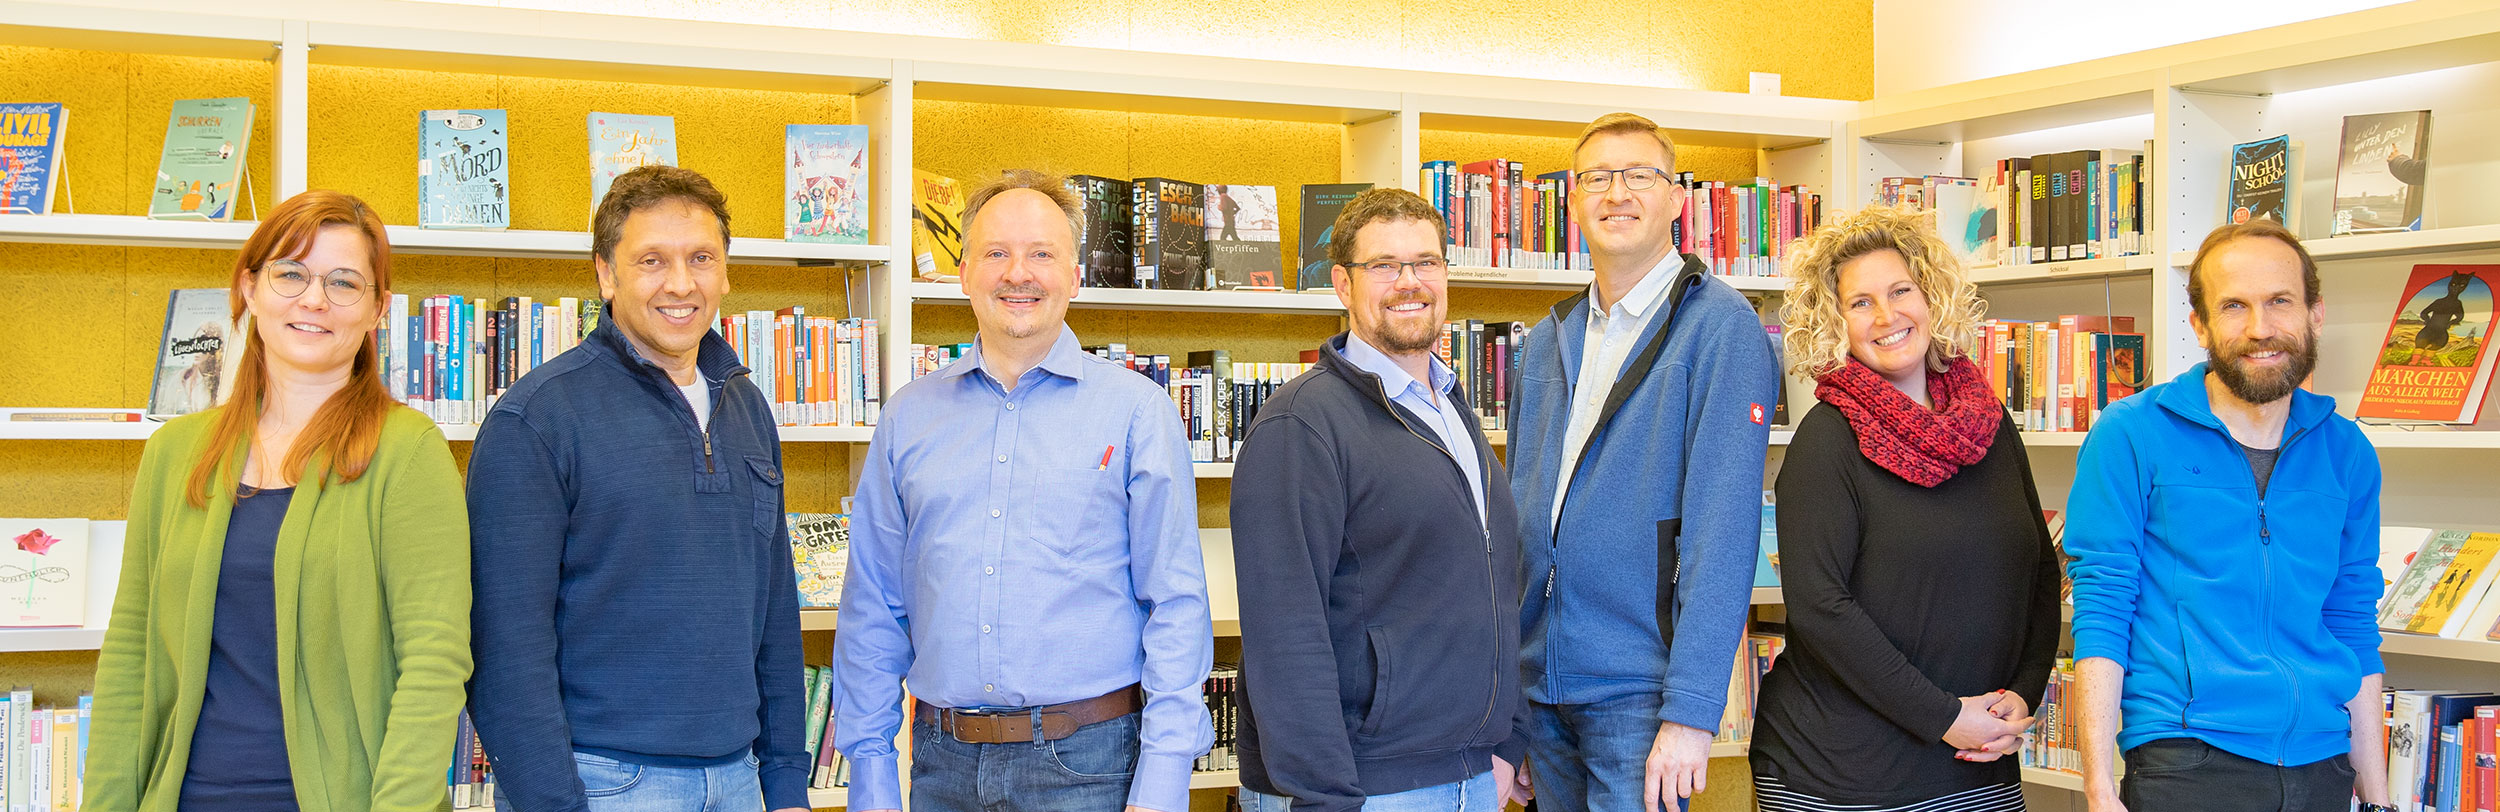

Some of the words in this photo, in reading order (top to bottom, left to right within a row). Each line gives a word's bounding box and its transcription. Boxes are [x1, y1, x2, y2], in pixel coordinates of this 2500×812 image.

[0, 113, 51, 134] IVIL
[2355, 122, 2382, 143] LILLY
[2381, 124, 2407, 145] DEN
[621, 128, 669, 153] Jahr
[437, 147, 502, 186] MORD
[604, 152, 637, 165] ohne
[2233, 150, 2285, 181] NIGHT
[2033, 175, 2041, 199] GONE
[2052, 173, 2061, 197] GONE
[2071, 170, 2080, 194] GONE
[2245, 167, 2287, 190] SCHOOL
[1089, 179, 1121, 203] ESCH
[1145, 190, 1158, 213] OUT
[1160, 181, 1193, 206] ESCH
[442, 202, 503, 223] DAMEN
[1133, 181, 1146, 267] ESCHBACH
[1170, 203, 1204, 228] BACH
[1145, 217, 1158, 244] TIME
[1215, 244, 1260, 254] Verpfiffen
[2049, 265, 2070, 273] Schicksal
[487, 317, 496, 328] 2
[2371, 368, 2473, 387] MÄRCHEN
[1216, 377, 1226, 410] RIDER
[2366, 385, 2392, 396] AUS
[2392, 386, 2429, 398] ALLER
[2432, 387, 2464, 399] WELT
[1216, 410, 1226, 438] ALEX
[799, 519, 841, 535] TOM
[805, 529, 849, 548] GATES
[2438, 543, 2484, 556] Hundert
[2436, 558, 2466, 568] Jahre
